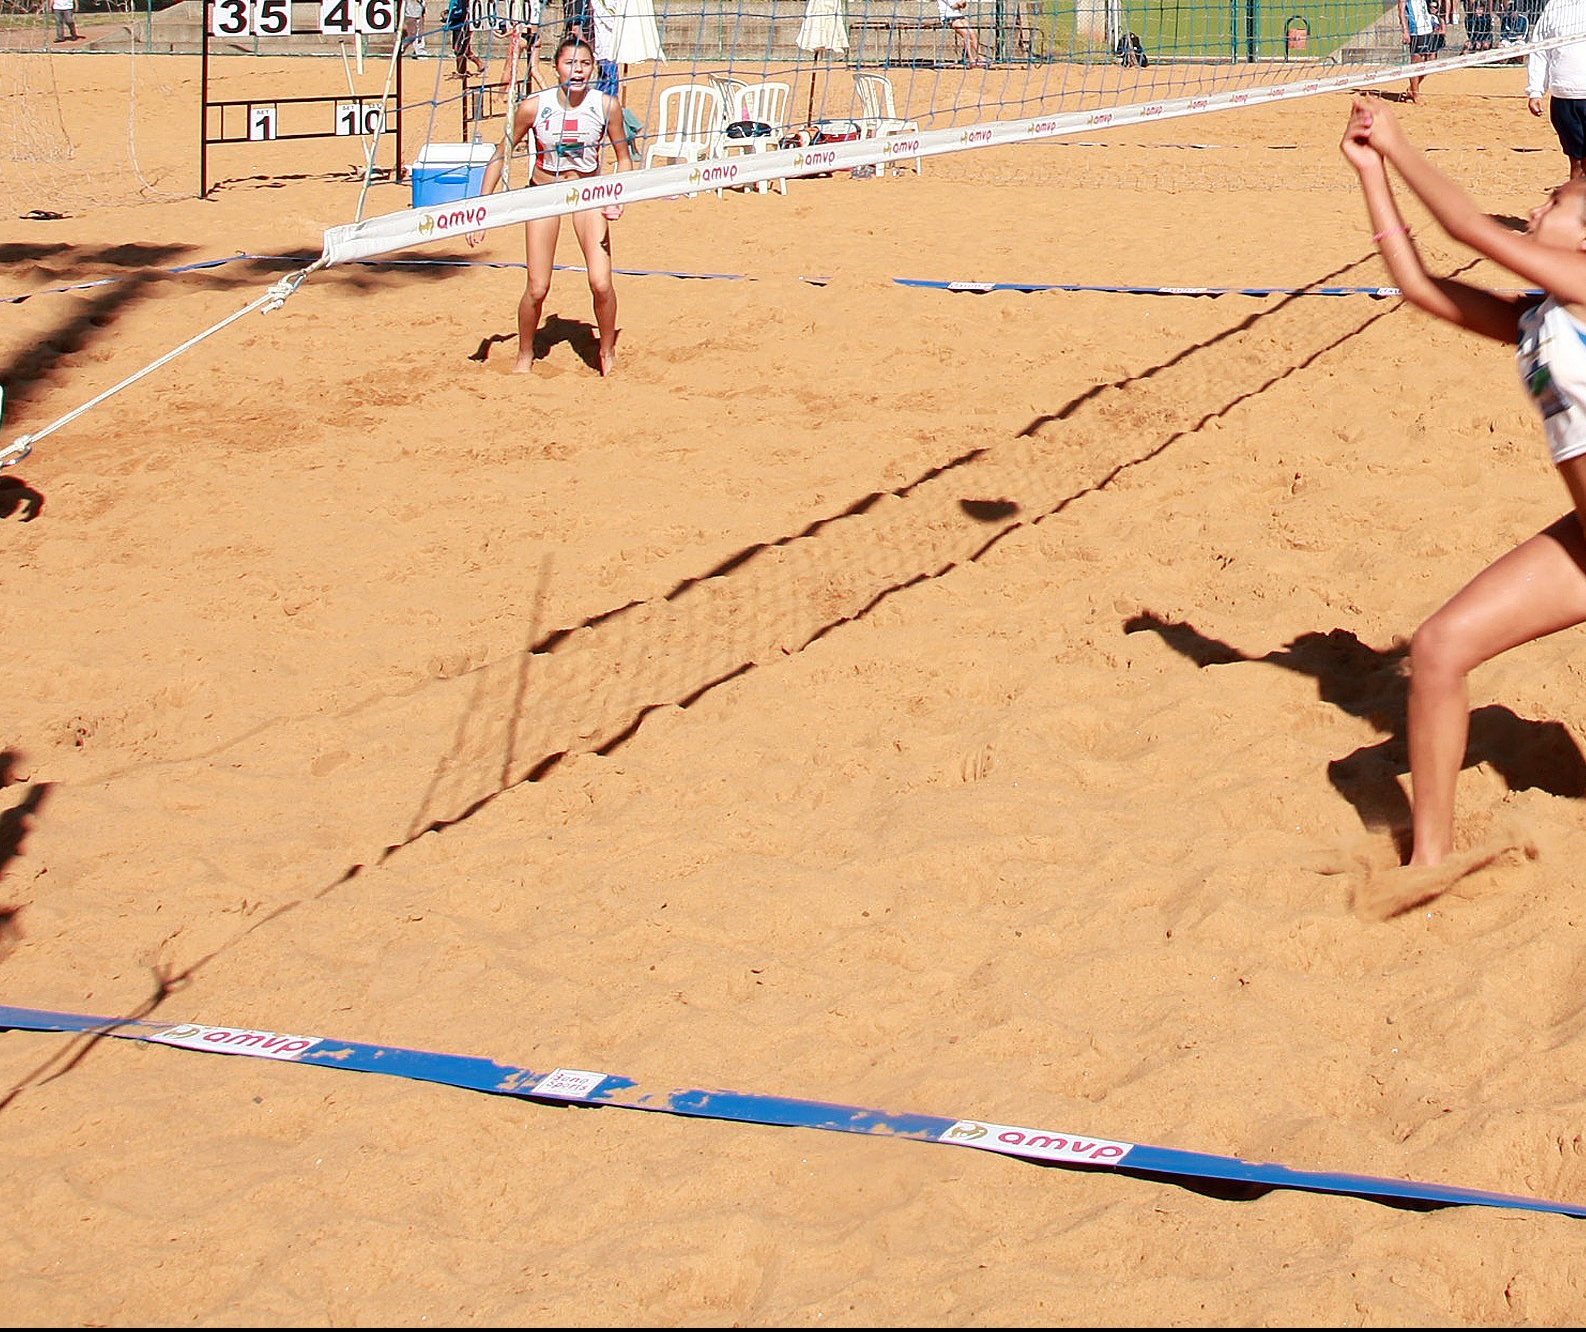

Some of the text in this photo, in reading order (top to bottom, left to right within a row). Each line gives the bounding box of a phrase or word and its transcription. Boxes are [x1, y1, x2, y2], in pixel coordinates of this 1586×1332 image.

[218, 0, 288, 35] 35
[256, 116, 271, 140] 1
[969, 128, 992, 143] amvp
[1035, 121, 1056, 134] amvp
[892, 139, 919, 155] amvp
[805, 150, 836, 167] amvp
[702, 164, 738, 183] amvp
[582, 182, 624, 201] amvp
[437, 206, 486, 230] amvp
[203, 1032, 310, 1054] amvp
[998, 1131, 1124, 1159] amvp
